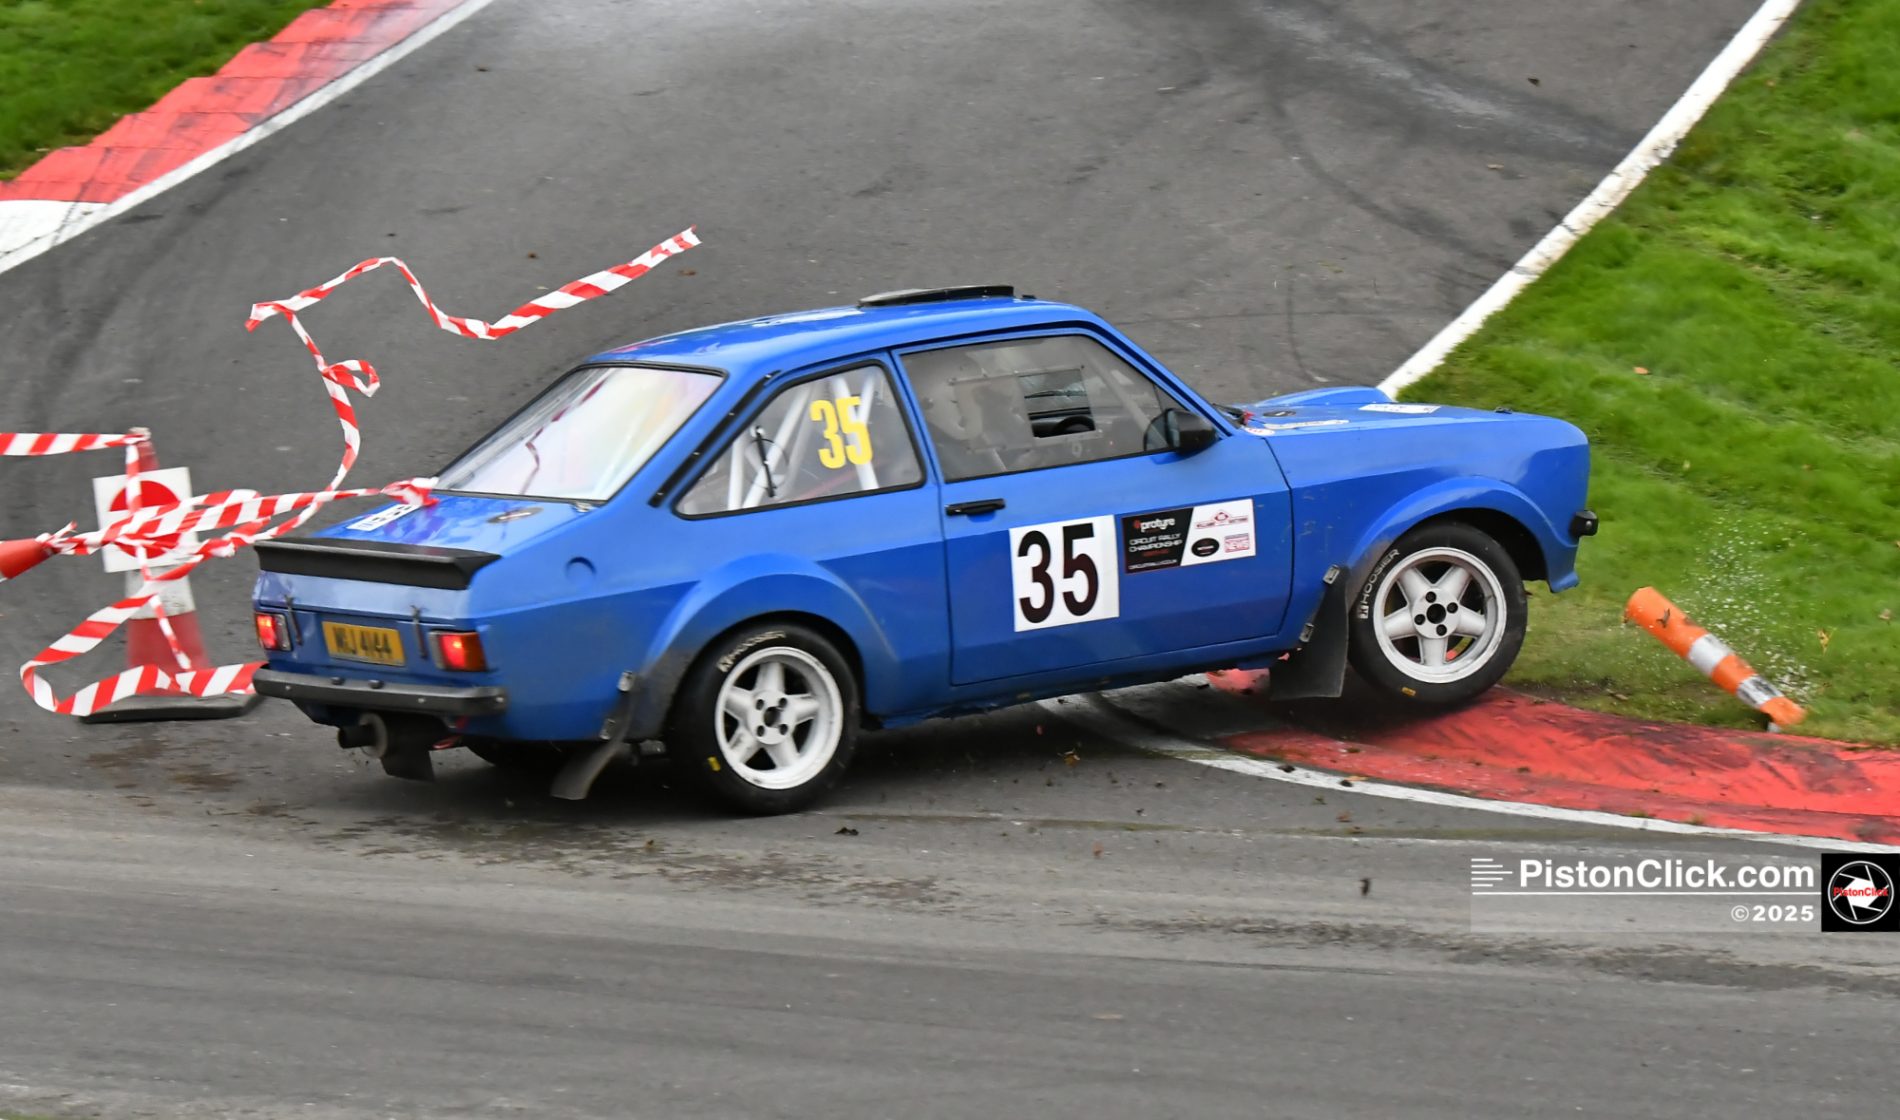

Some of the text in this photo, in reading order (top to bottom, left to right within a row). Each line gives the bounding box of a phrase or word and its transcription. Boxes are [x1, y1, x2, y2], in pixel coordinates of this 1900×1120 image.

[809, 396, 873, 469] 35
[1140, 518, 1175, 532] protyre
[1017, 522, 1099, 624] 35
[1359, 549, 1400, 605] HOOSIER
